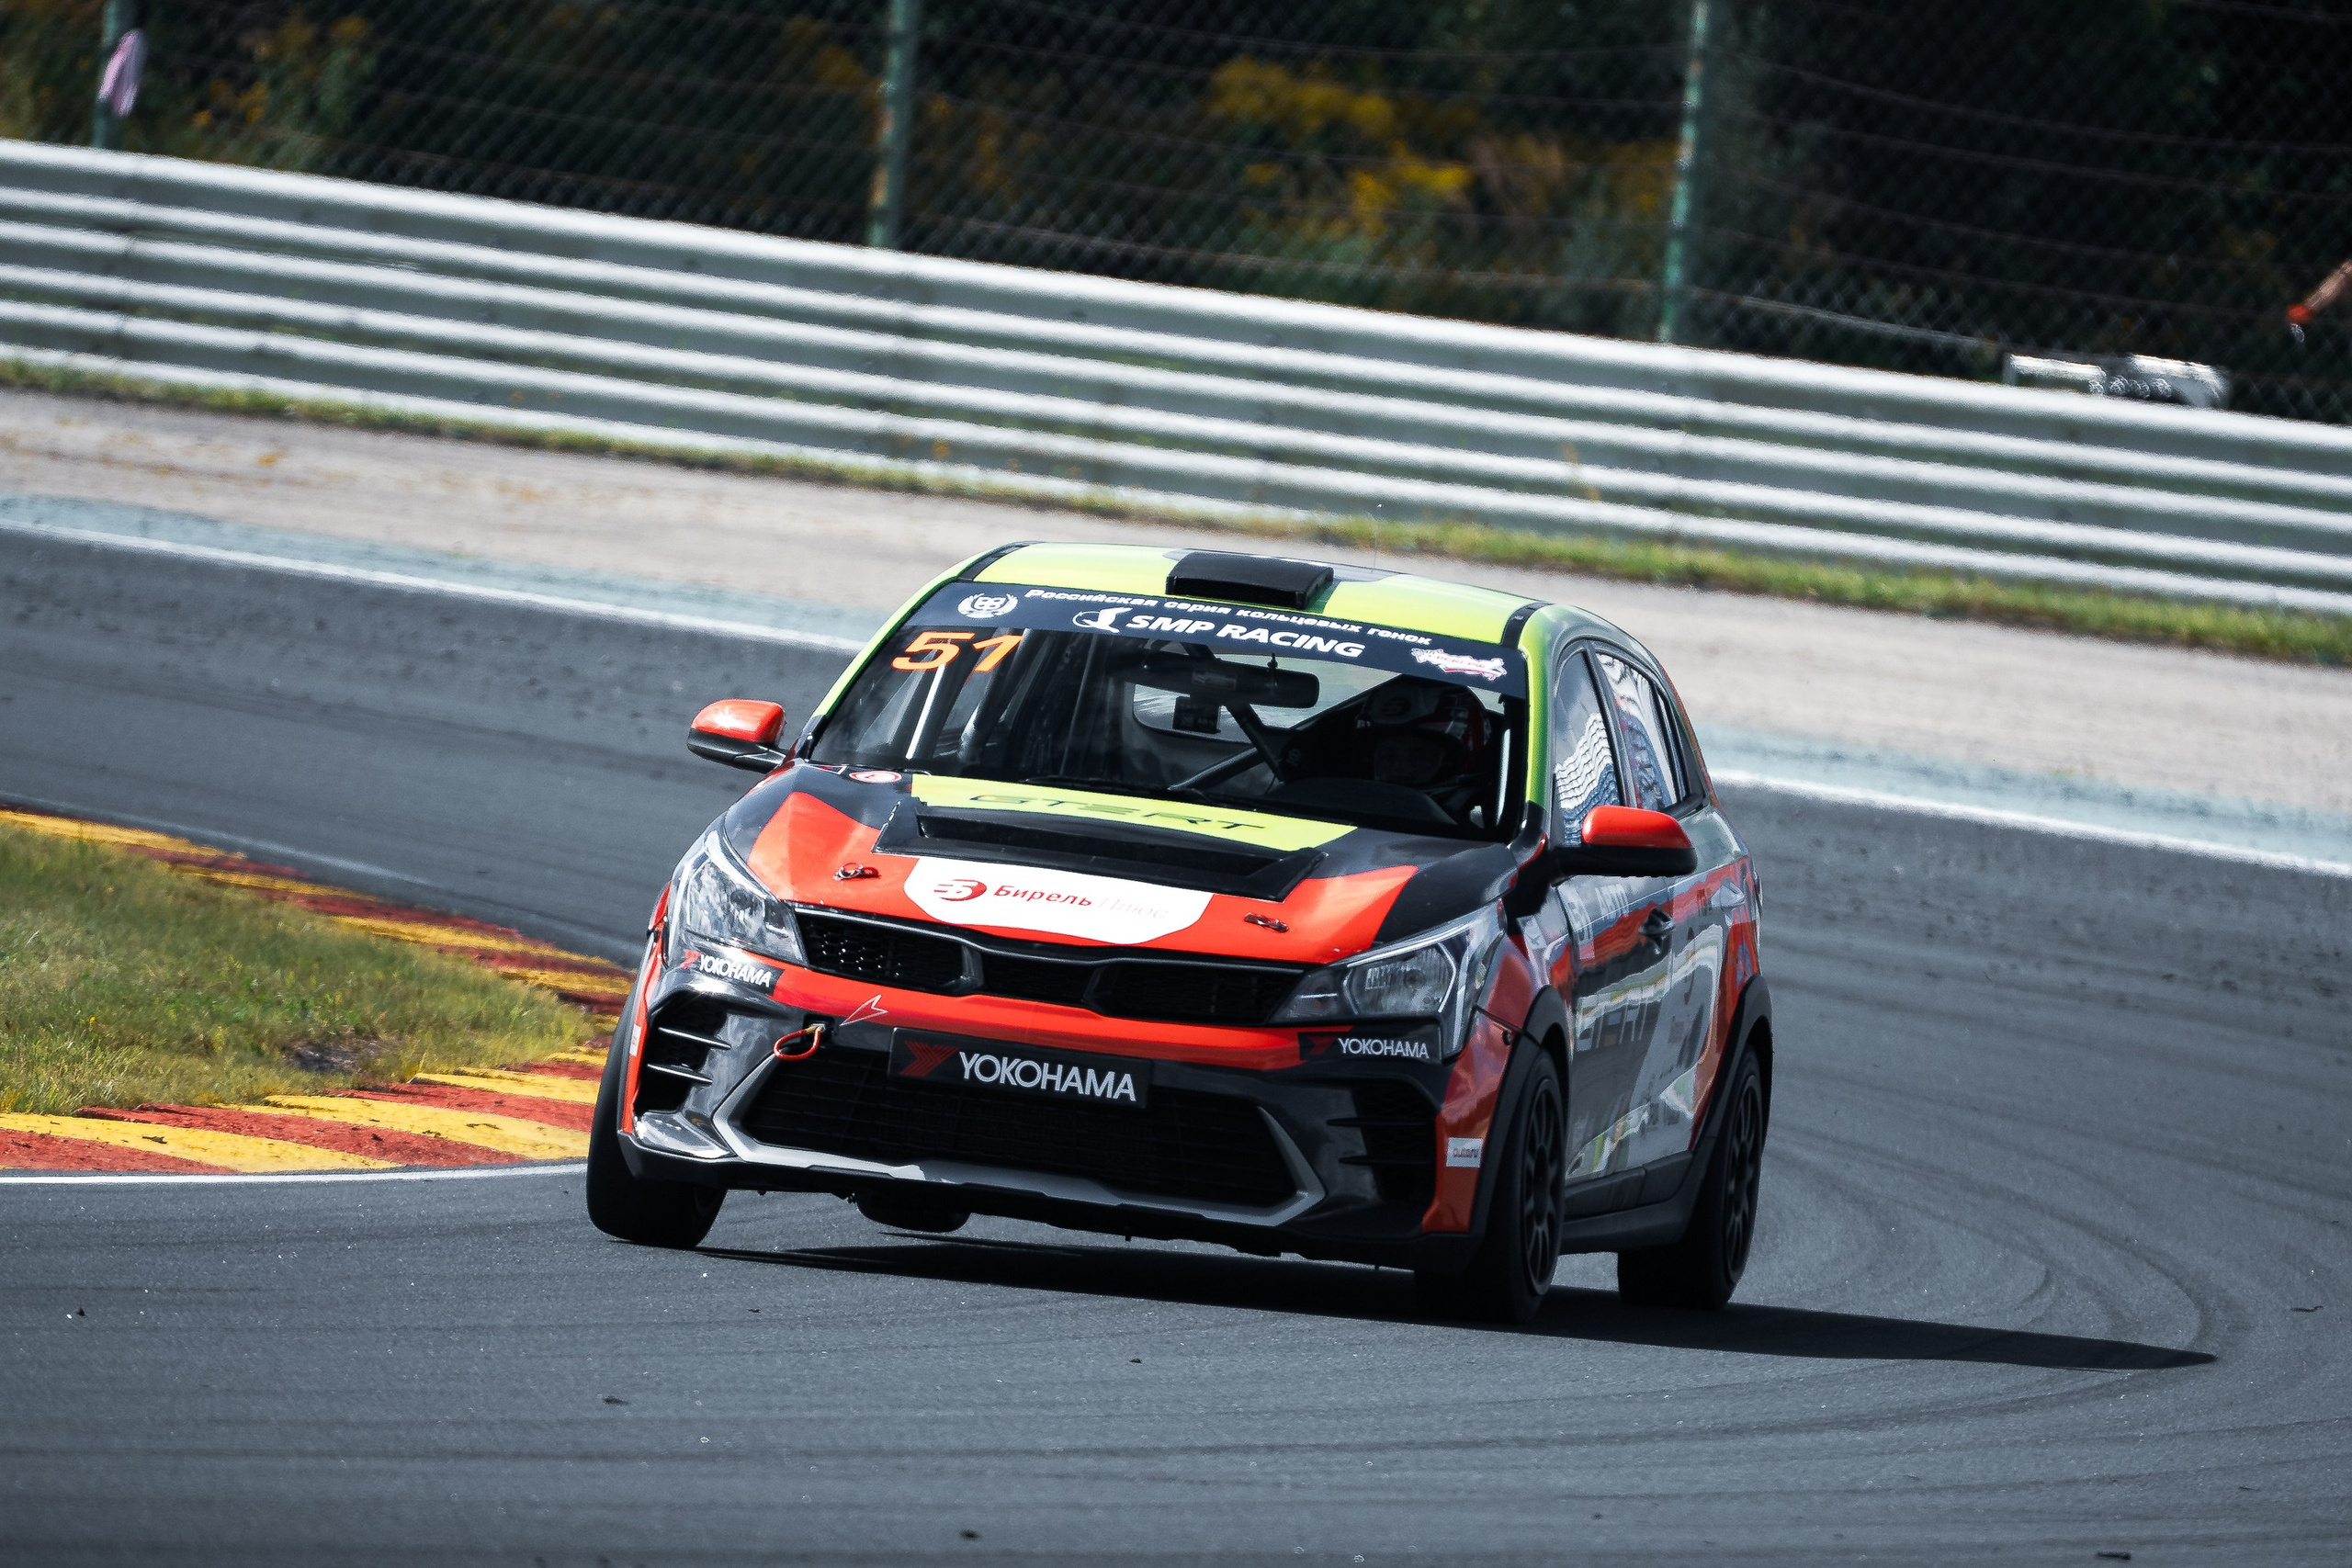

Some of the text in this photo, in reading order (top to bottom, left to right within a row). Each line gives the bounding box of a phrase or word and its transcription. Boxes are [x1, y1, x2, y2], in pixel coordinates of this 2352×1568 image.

[1024, 589, 1159, 607] Российская
[1367, 626, 1432, 646] гонок
[1125, 614, 1366, 658] SMP RACING
[890, 630, 1024, 673] 51
[993, 884, 1092, 908] Бирель
[696, 953, 775, 988] YOKOHAMA
[1338, 1037, 1430, 1059] YOKOHAMA
[958, 1051, 1137, 1103] YOKOHAMA
